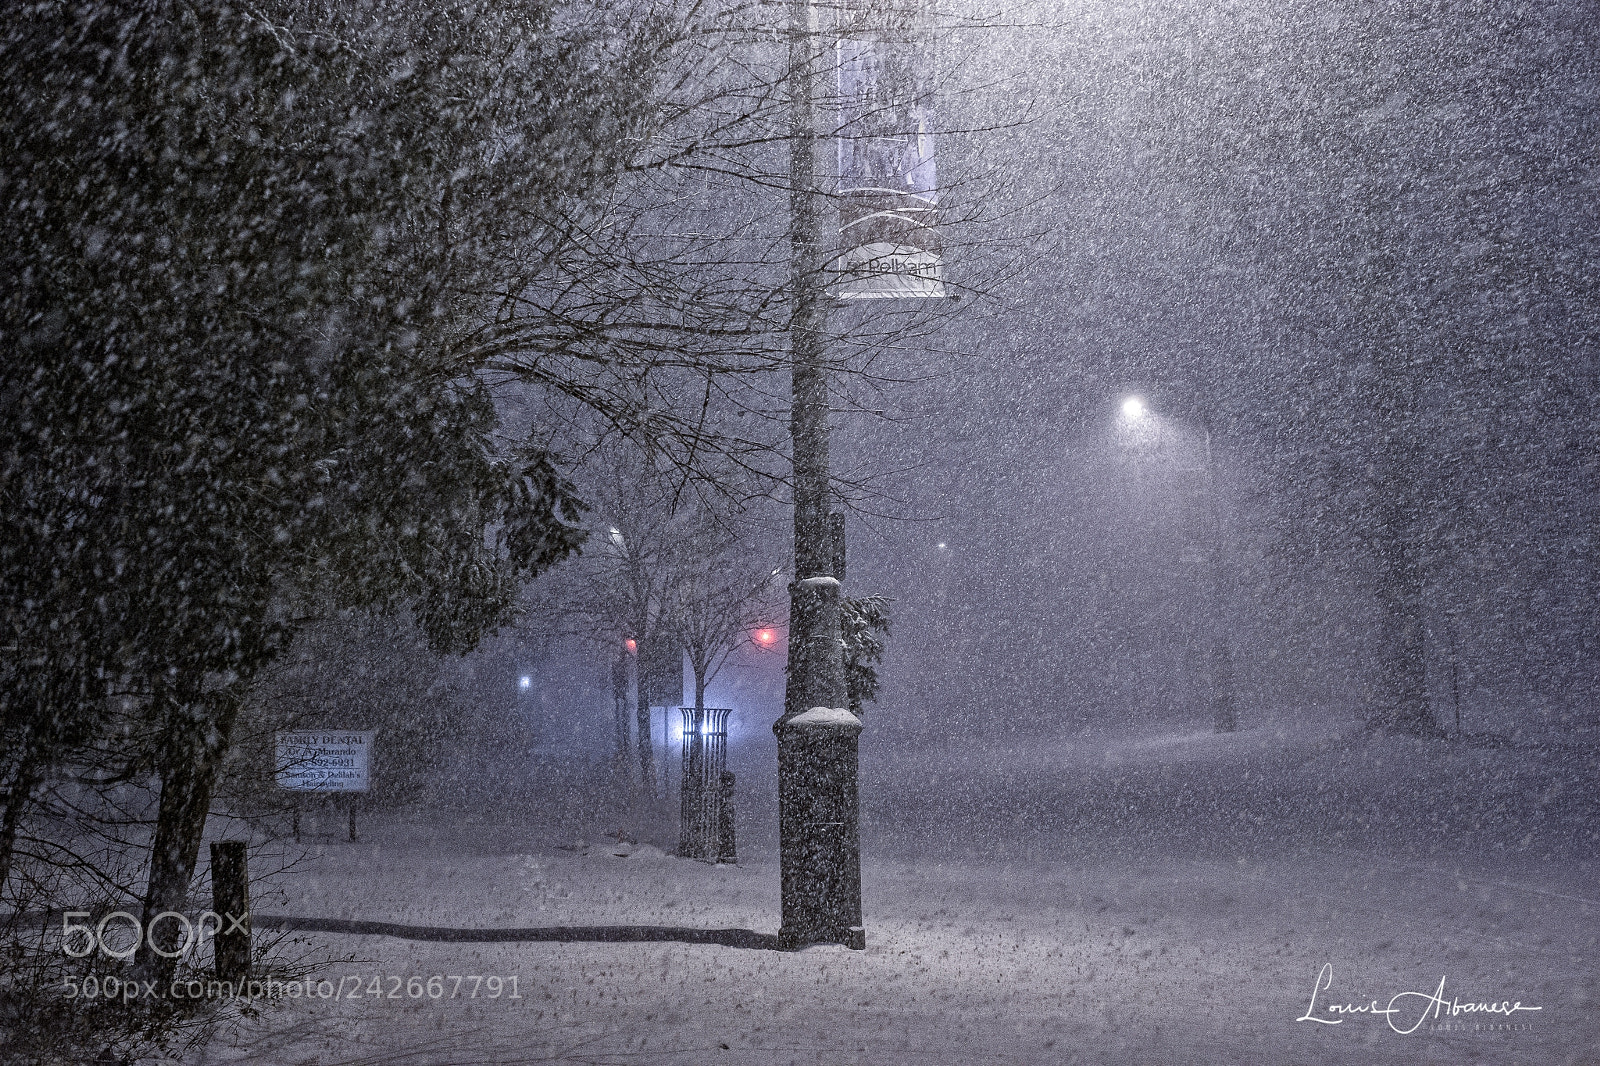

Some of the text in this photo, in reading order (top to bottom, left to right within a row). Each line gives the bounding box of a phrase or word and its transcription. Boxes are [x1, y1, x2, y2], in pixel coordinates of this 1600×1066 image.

[869, 258, 937, 276] Pelham
[281, 735, 365, 745] FAMILY DENTAL
[319, 747, 357, 756] Marando
[290, 758, 355, 767] 95-892-6931
[318, 771, 326, 779] &
[328, 771, 361, 779] Delilah's
[302, 780, 344, 788] Hairyling
